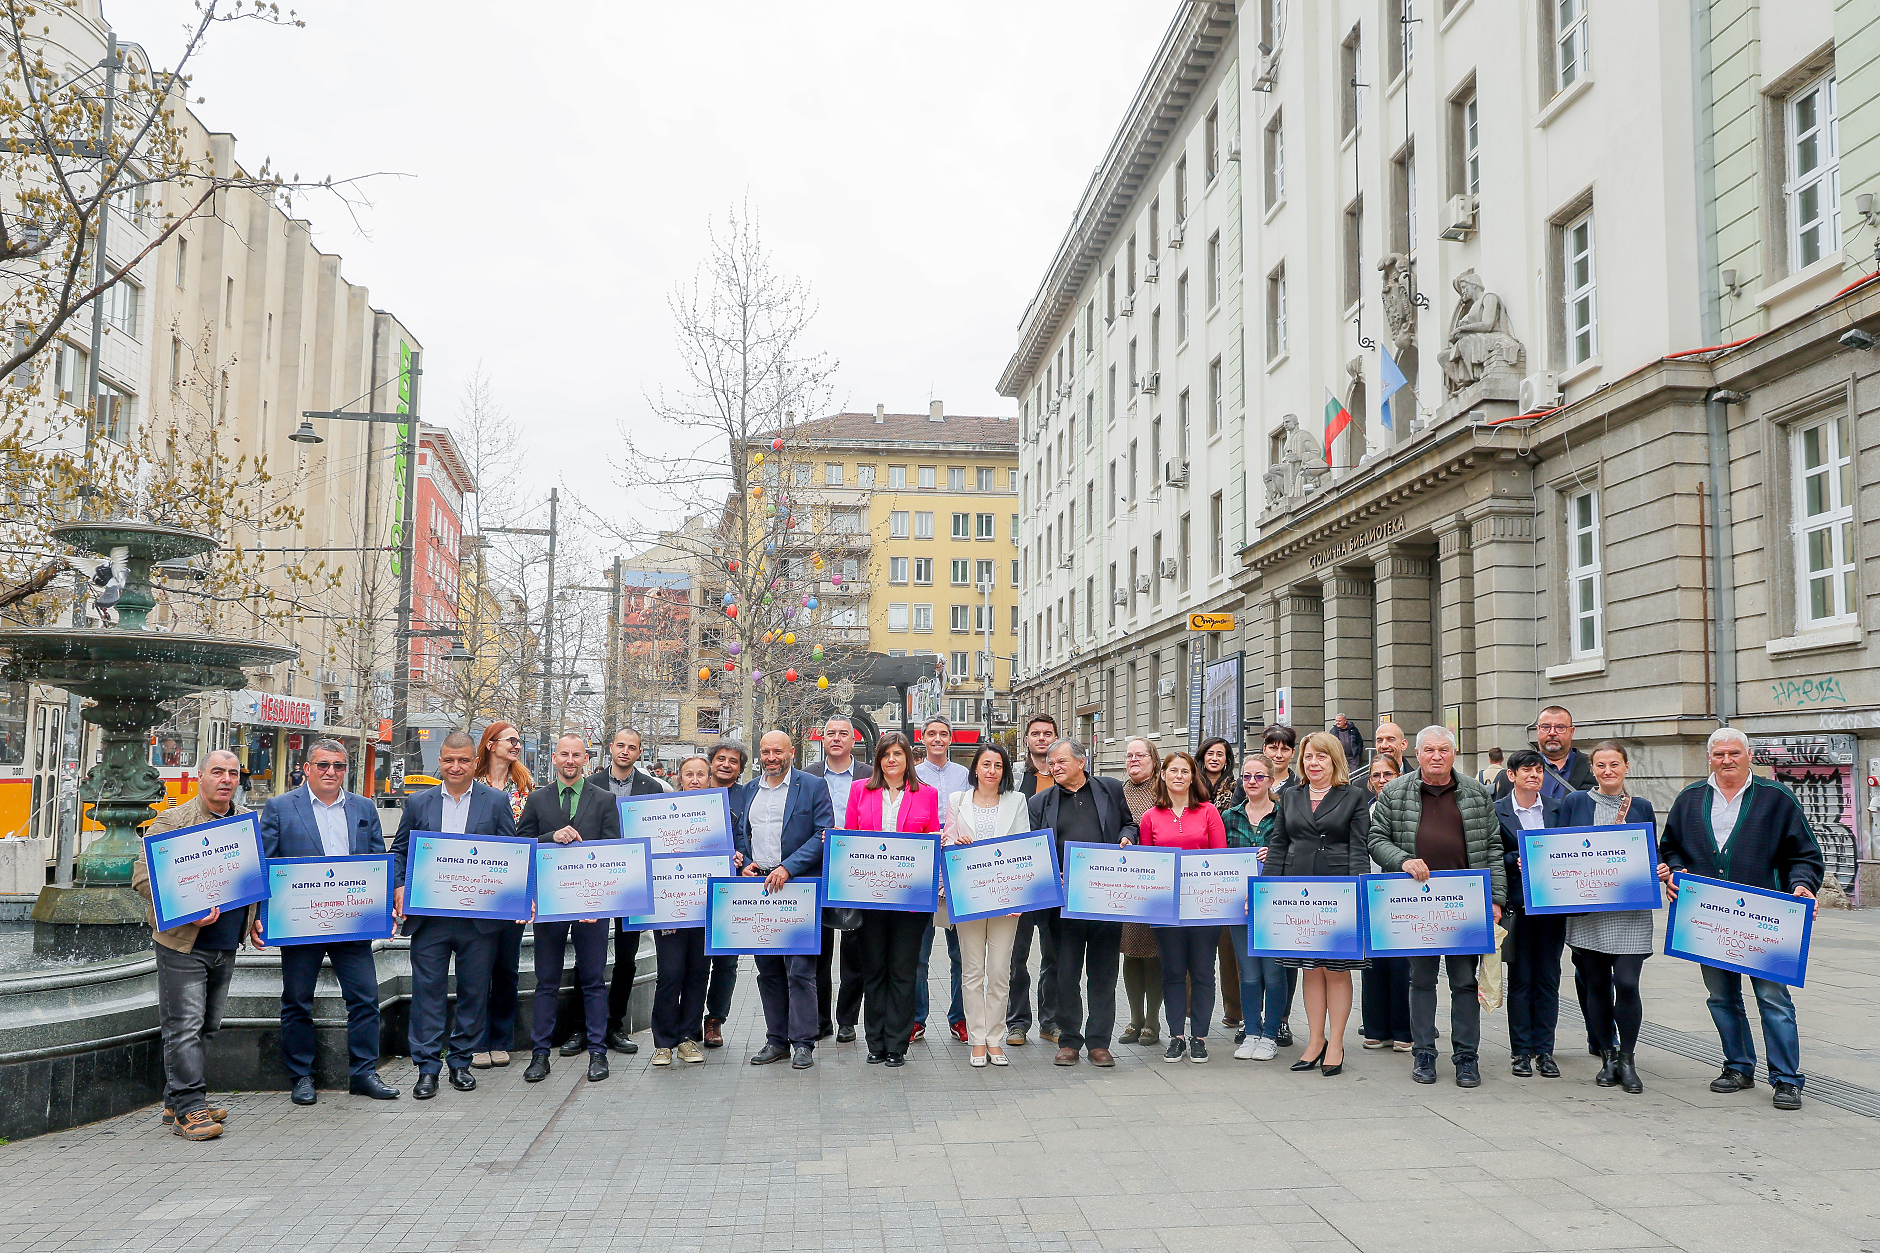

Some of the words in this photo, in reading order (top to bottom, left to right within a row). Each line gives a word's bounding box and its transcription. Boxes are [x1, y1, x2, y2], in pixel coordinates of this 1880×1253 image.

[1309, 541, 1347, 569] СТОЛИЧНА
[1349, 515, 1406, 552] БИБЛИОТЕКА
[260, 694, 310, 728] HESBURGER
[682, 810, 706, 818] капка
[174, 853, 200, 864] капка
[215, 842, 239, 854] капка
[223, 850, 240, 860] 2026
[1596, 849, 1626, 857] капка
[436, 856, 464, 864] капка
[481, 859, 508, 867] капка
[967, 861, 992, 871] капка
[1007, 855, 1032, 864] капка
[1606, 856, 1627, 864] 2026
[557, 862, 584, 870] капка
[292, 881, 321, 889] капка
[338, 879, 366, 887] капка
[347, 886, 366, 894] 2026
[1390, 896, 1418, 904] капка
[1700, 902, 1730, 913] капка
[1749, 913, 1780, 925] капка
[1757, 922, 1778, 932] 2026
